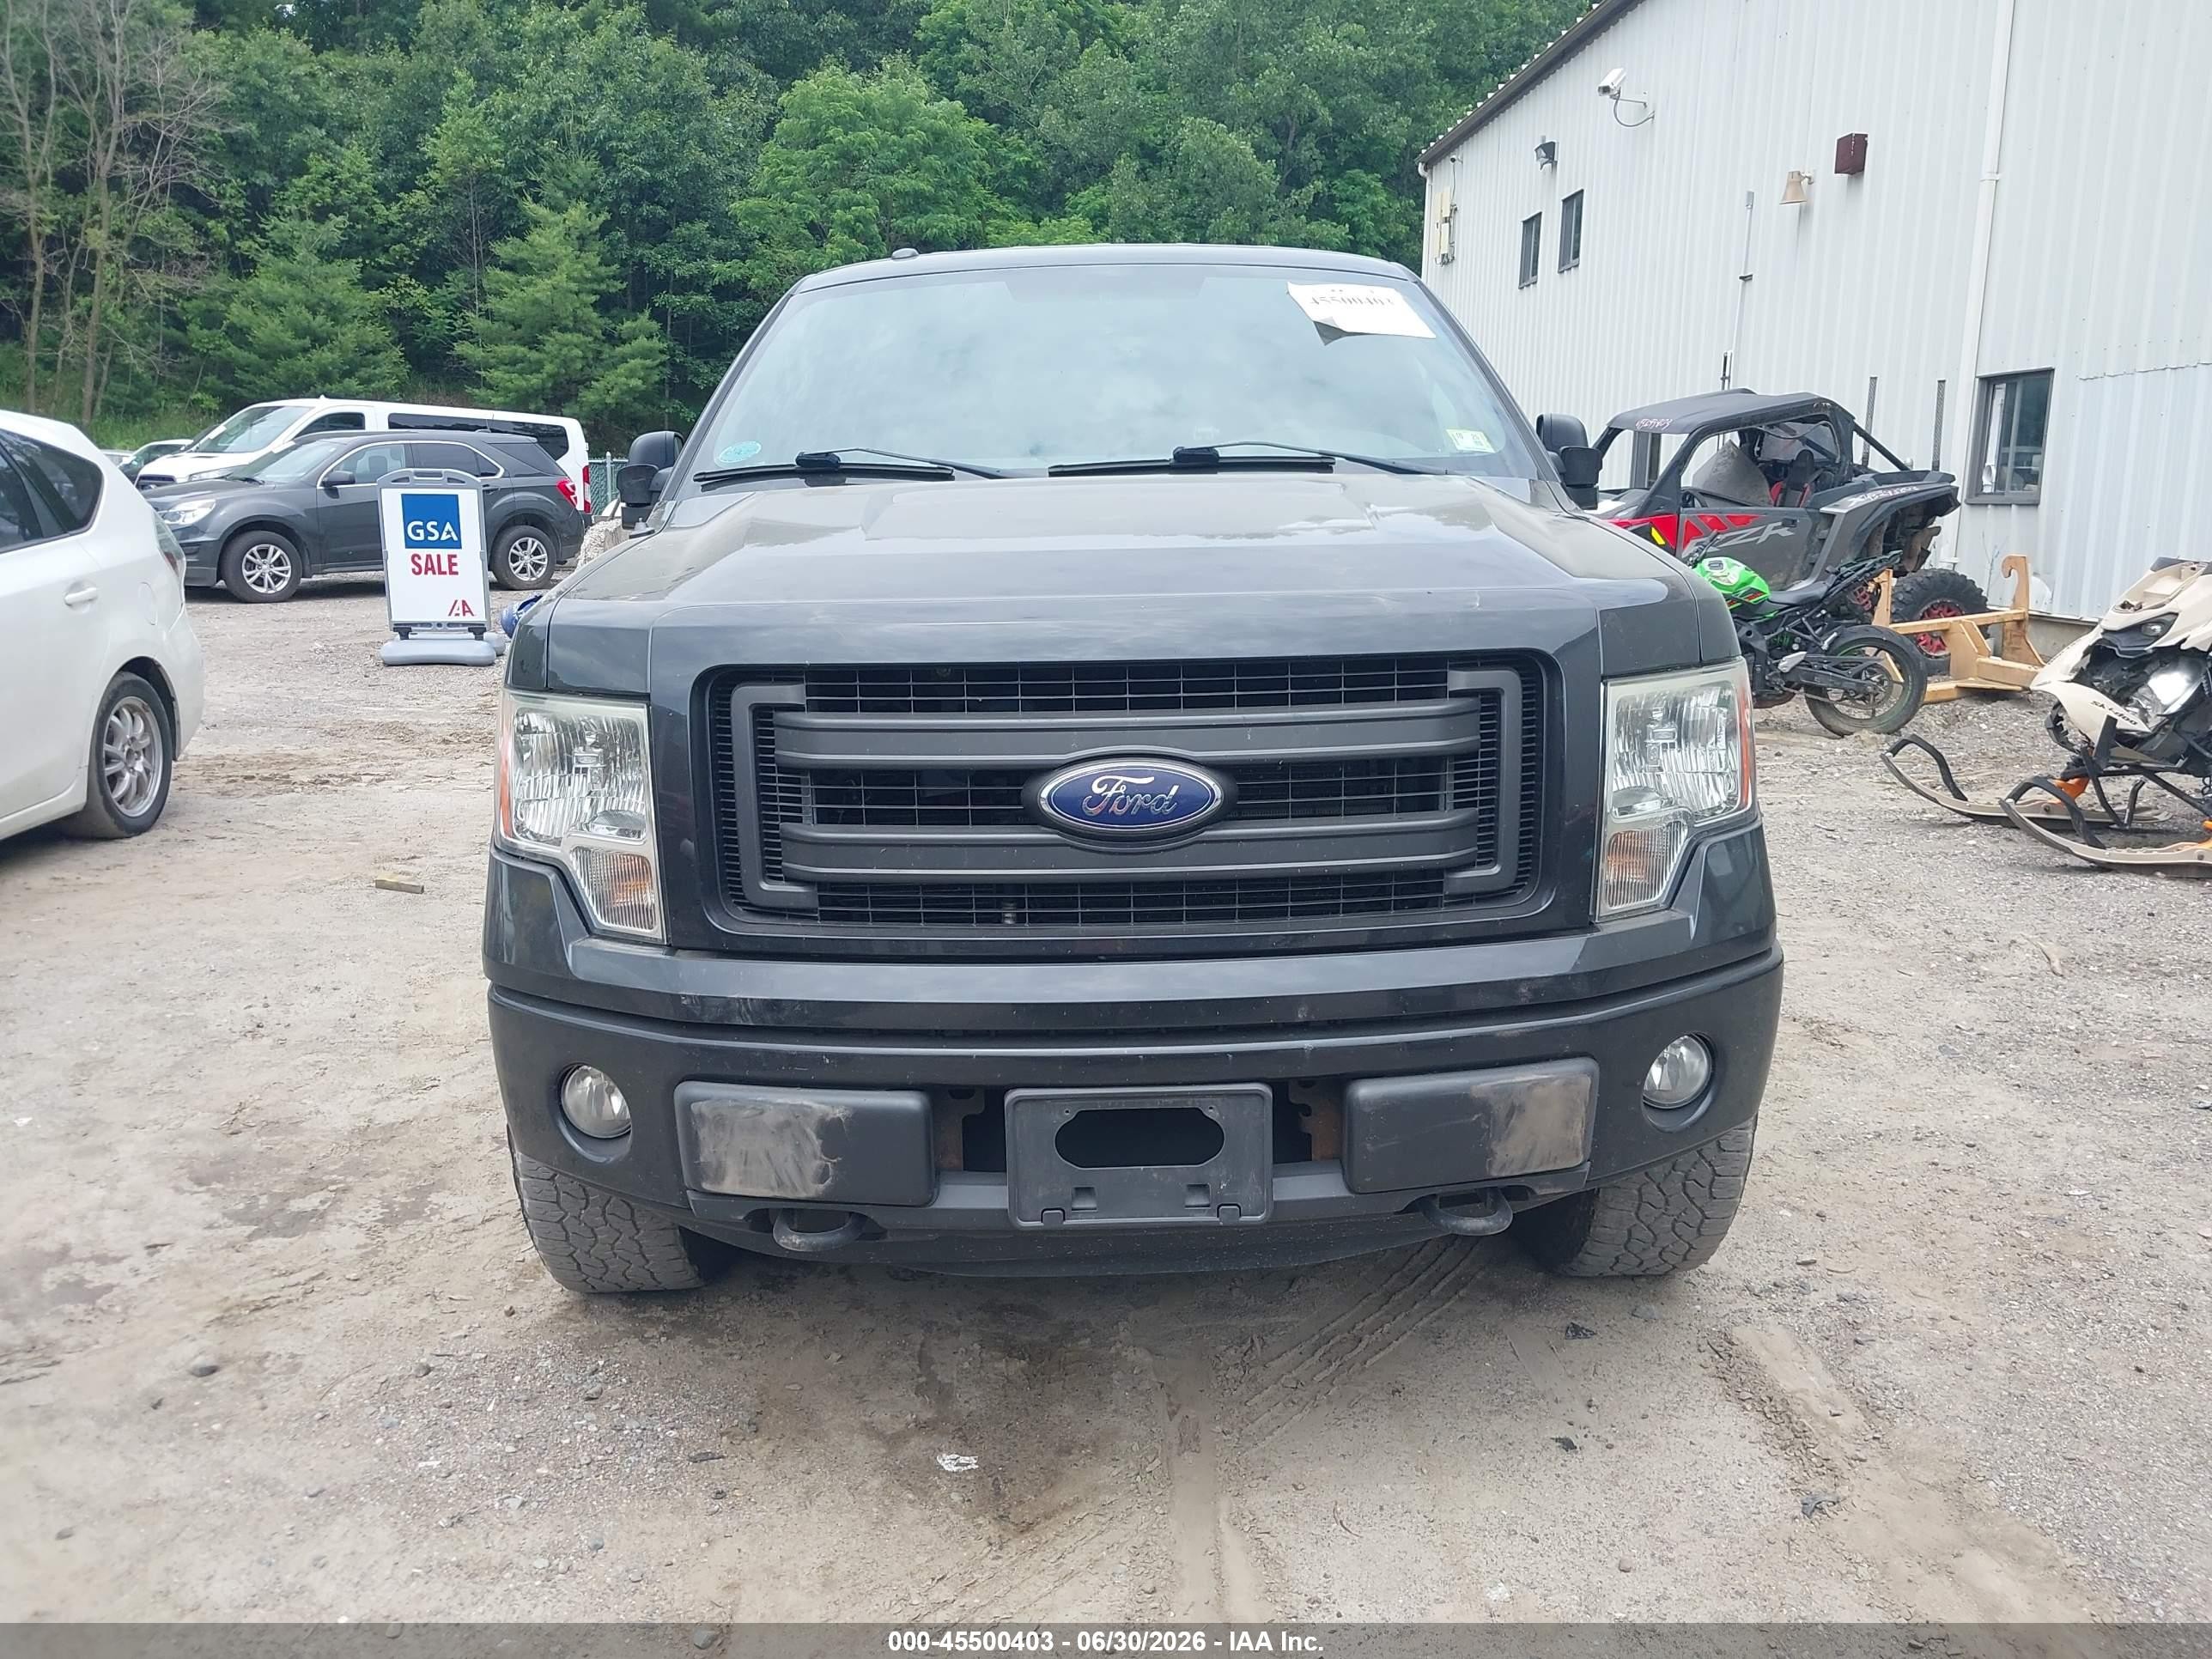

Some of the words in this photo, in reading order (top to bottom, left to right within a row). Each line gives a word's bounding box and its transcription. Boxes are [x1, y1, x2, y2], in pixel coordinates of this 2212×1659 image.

[407, 520, 459, 541] GSA
[410, 553, 459, 575] SALE
[1082, 775, 1180, 815] Ford
